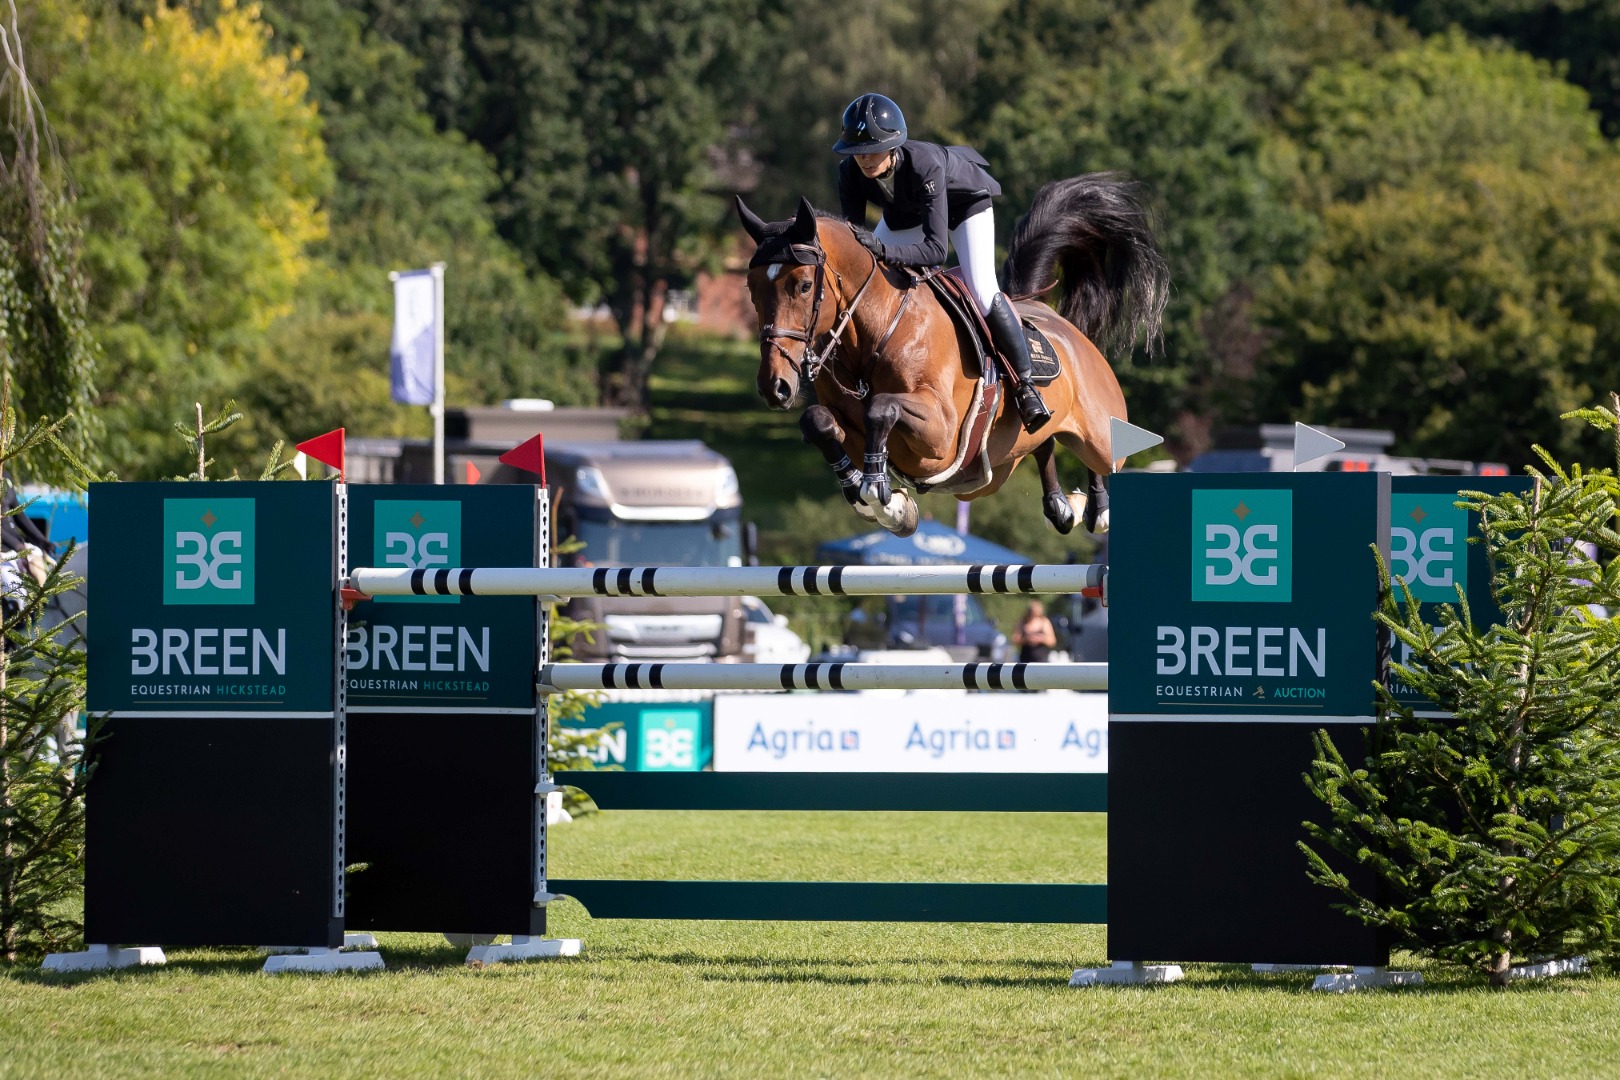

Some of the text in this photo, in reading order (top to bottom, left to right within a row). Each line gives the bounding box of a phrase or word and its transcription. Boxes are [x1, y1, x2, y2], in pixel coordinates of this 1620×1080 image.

[131, 628, 286, 675] BREEN
[346, 625, 490, 672] BREEN
[1156, 625, 1326, 678] BREEN
[131, 685, 286, 695] EQUESTRIAN HICKSTEAD
[423, 681, 490, 691] HICKSTEAD
[1156, 685, 1326, 699] EQUESTRIAN AUCTION
[747, 721, 833, 759] Agria
[905, 720, 990, 759] Agria
